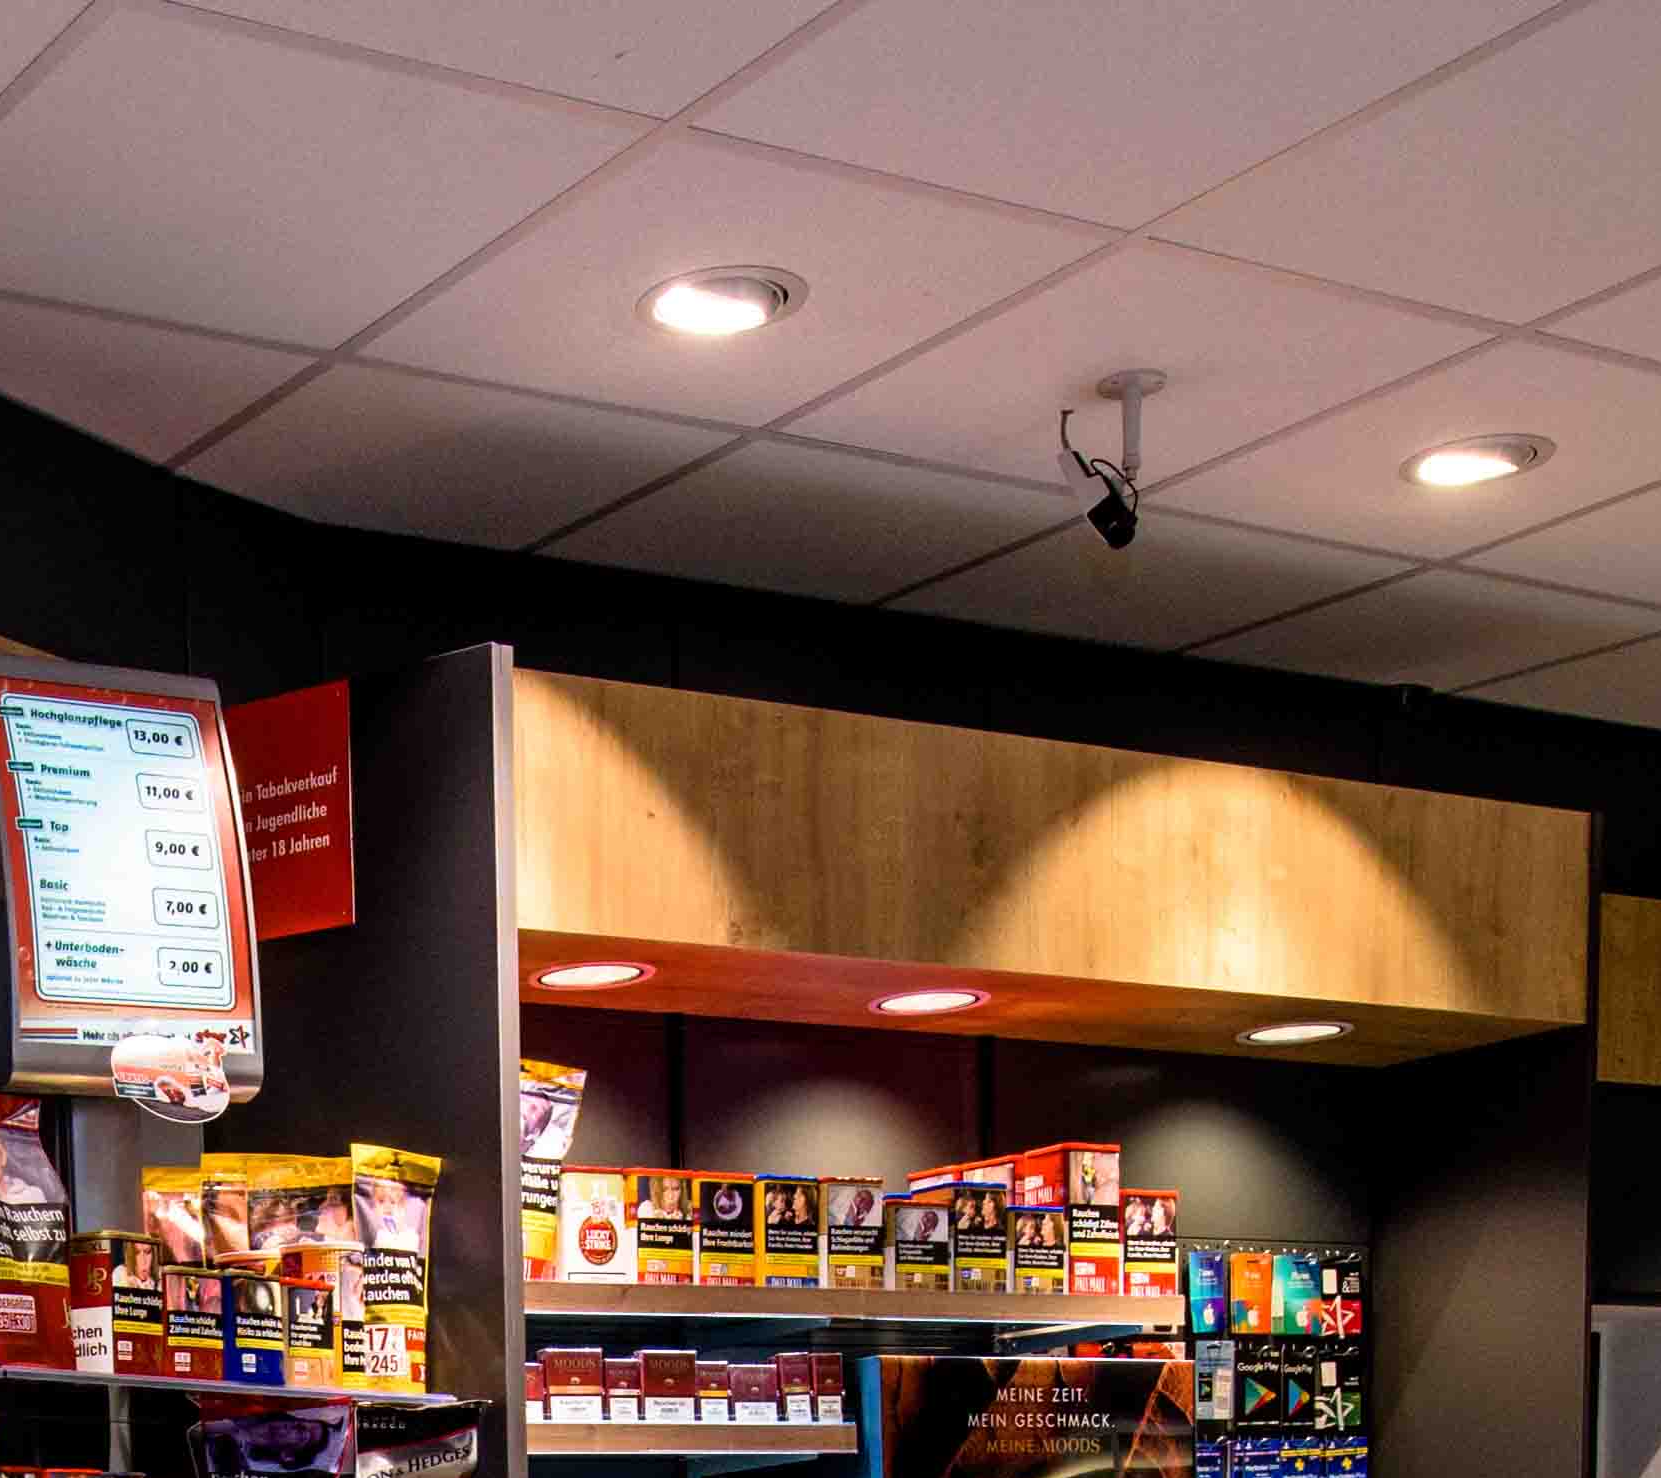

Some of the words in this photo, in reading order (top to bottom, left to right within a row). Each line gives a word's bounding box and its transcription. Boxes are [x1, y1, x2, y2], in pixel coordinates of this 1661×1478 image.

[30, 708, 123, 729] Hochglanzpflege
[133, 729, 169, 745] 13,00
[40, 763, 91, 779] Premium
[144, 785, 180, 801] 11,00
[255, 767, 339, 802] Tabakverkauf
[255, 804, 328, 833] Jugendliche
[49, 819, 69, 834] Top
[154, 841, 188, 857] 9,00
[271, 840, 287, 859] 18
[289, 833, 331, 856] Jahren
[39, 879, 69, 891] Basic
[165, 900, 194, 917] 7,00
[55, 956, 97, 970] wäsche
[996, 1388, 1043, 1403] MEINE
[1052, 1388, 1088, 1403] ZEIT.
[968, 1413, 1007, 1428] MEIN
[1015, 1413, 1115, 1428] GESCHMACK.
[986, 1439, 1033, 1452] MEINE
[1042, 1438, 1101, 1454] MOODS
